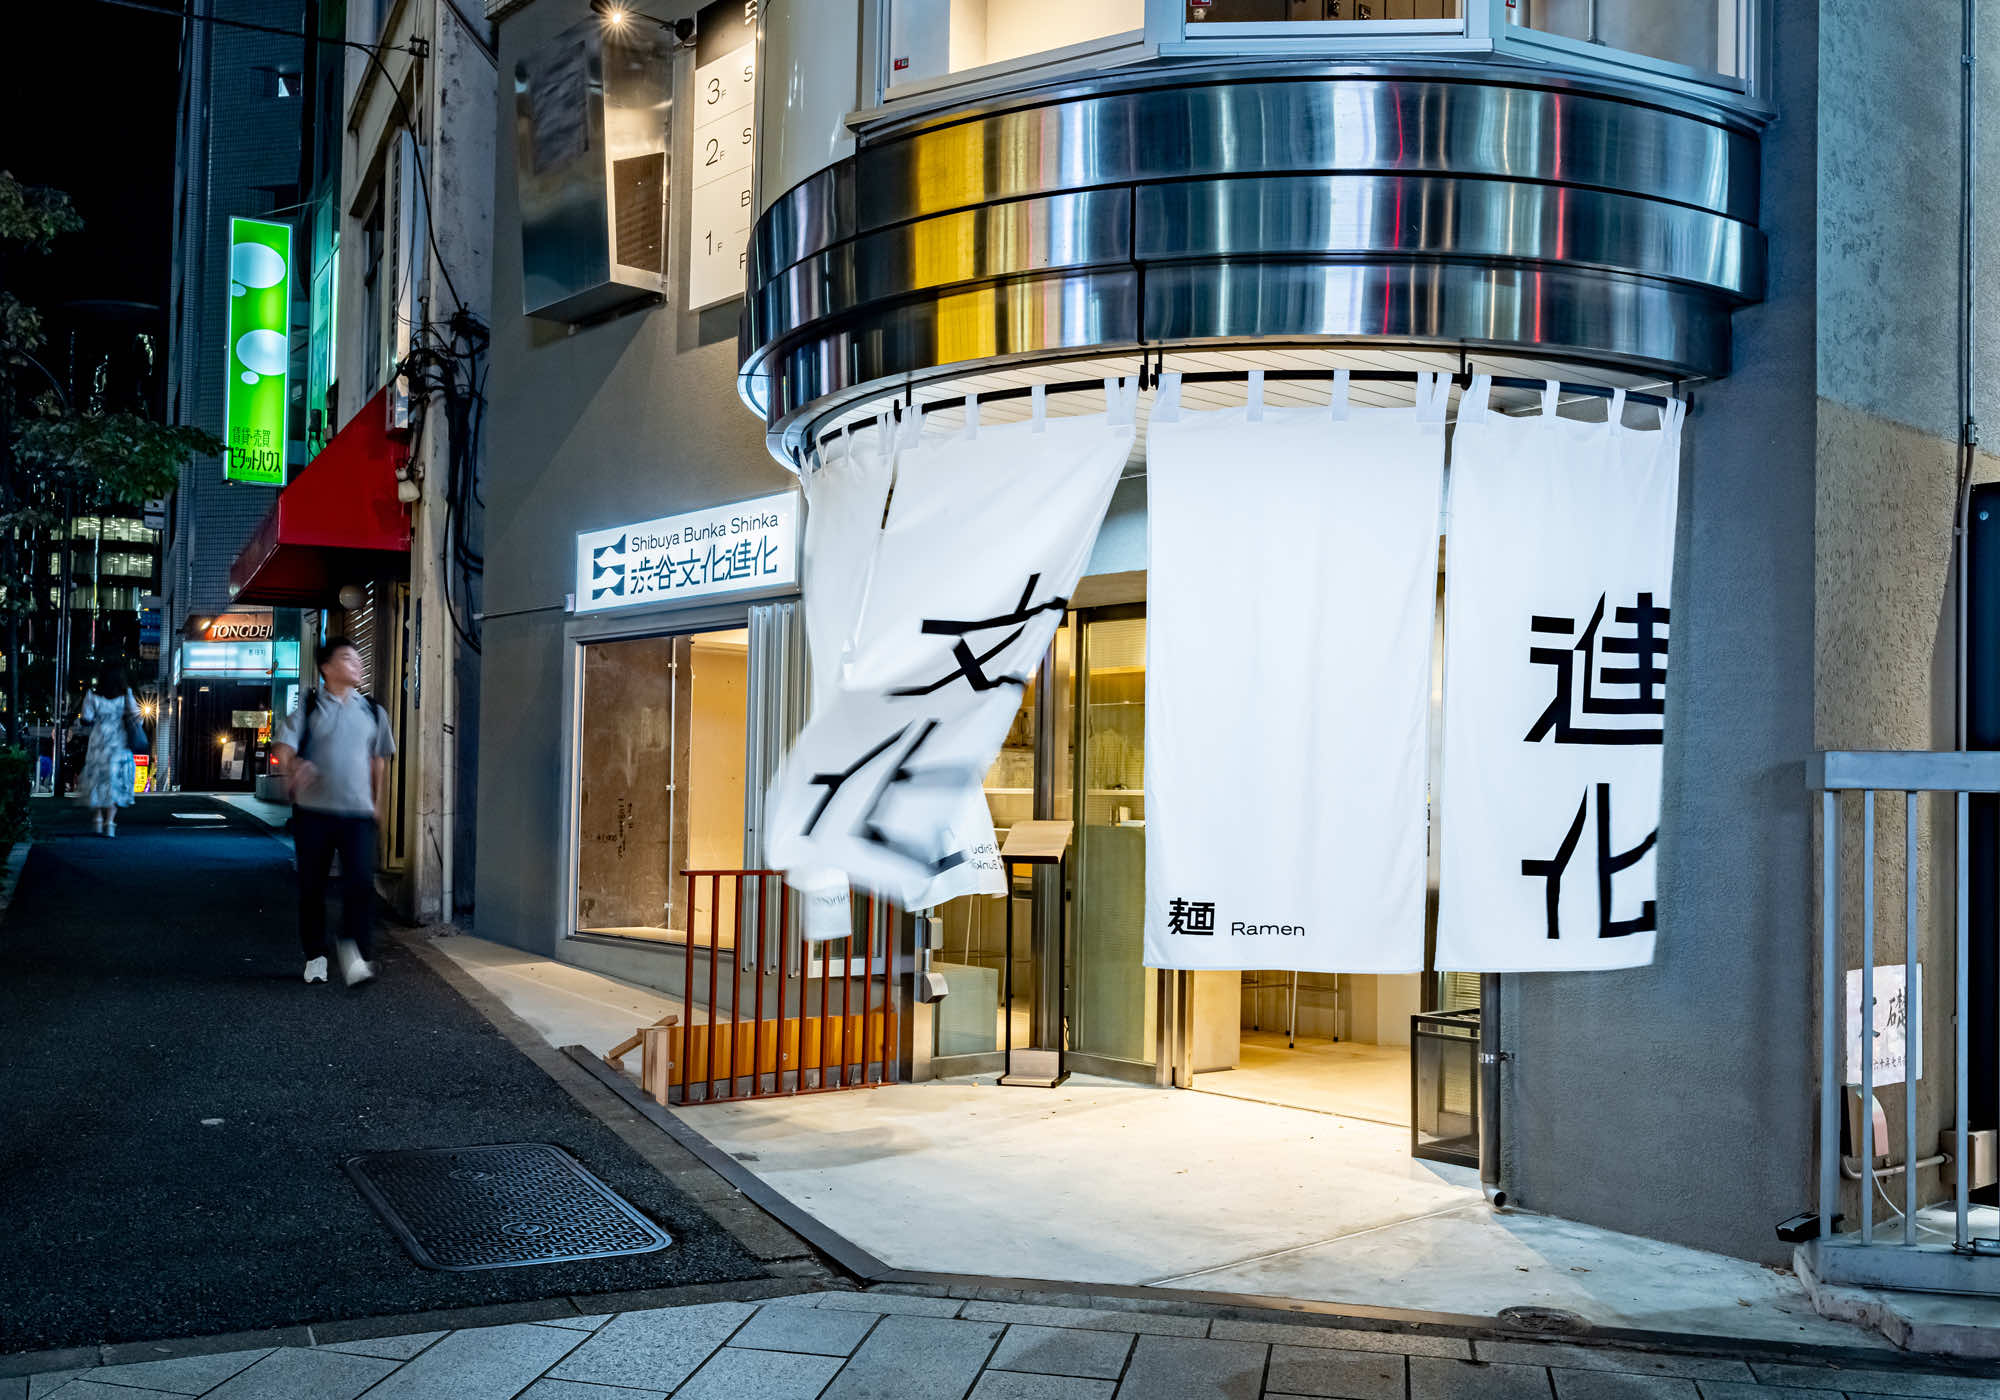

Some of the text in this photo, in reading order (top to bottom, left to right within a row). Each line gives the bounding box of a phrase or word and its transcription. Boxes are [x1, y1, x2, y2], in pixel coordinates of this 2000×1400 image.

[231, 446, 281, 473] ピタットハウス
[631, 513, 778, 552] Shibuya Bunka Shinka
[630, 535, 778, 594] 渋谷文化進化
[1521, 590, 1670, 939] 進化
[1168, 897, 1215, 936] 麺
[1231, 922, 1305, 936] Ramen
